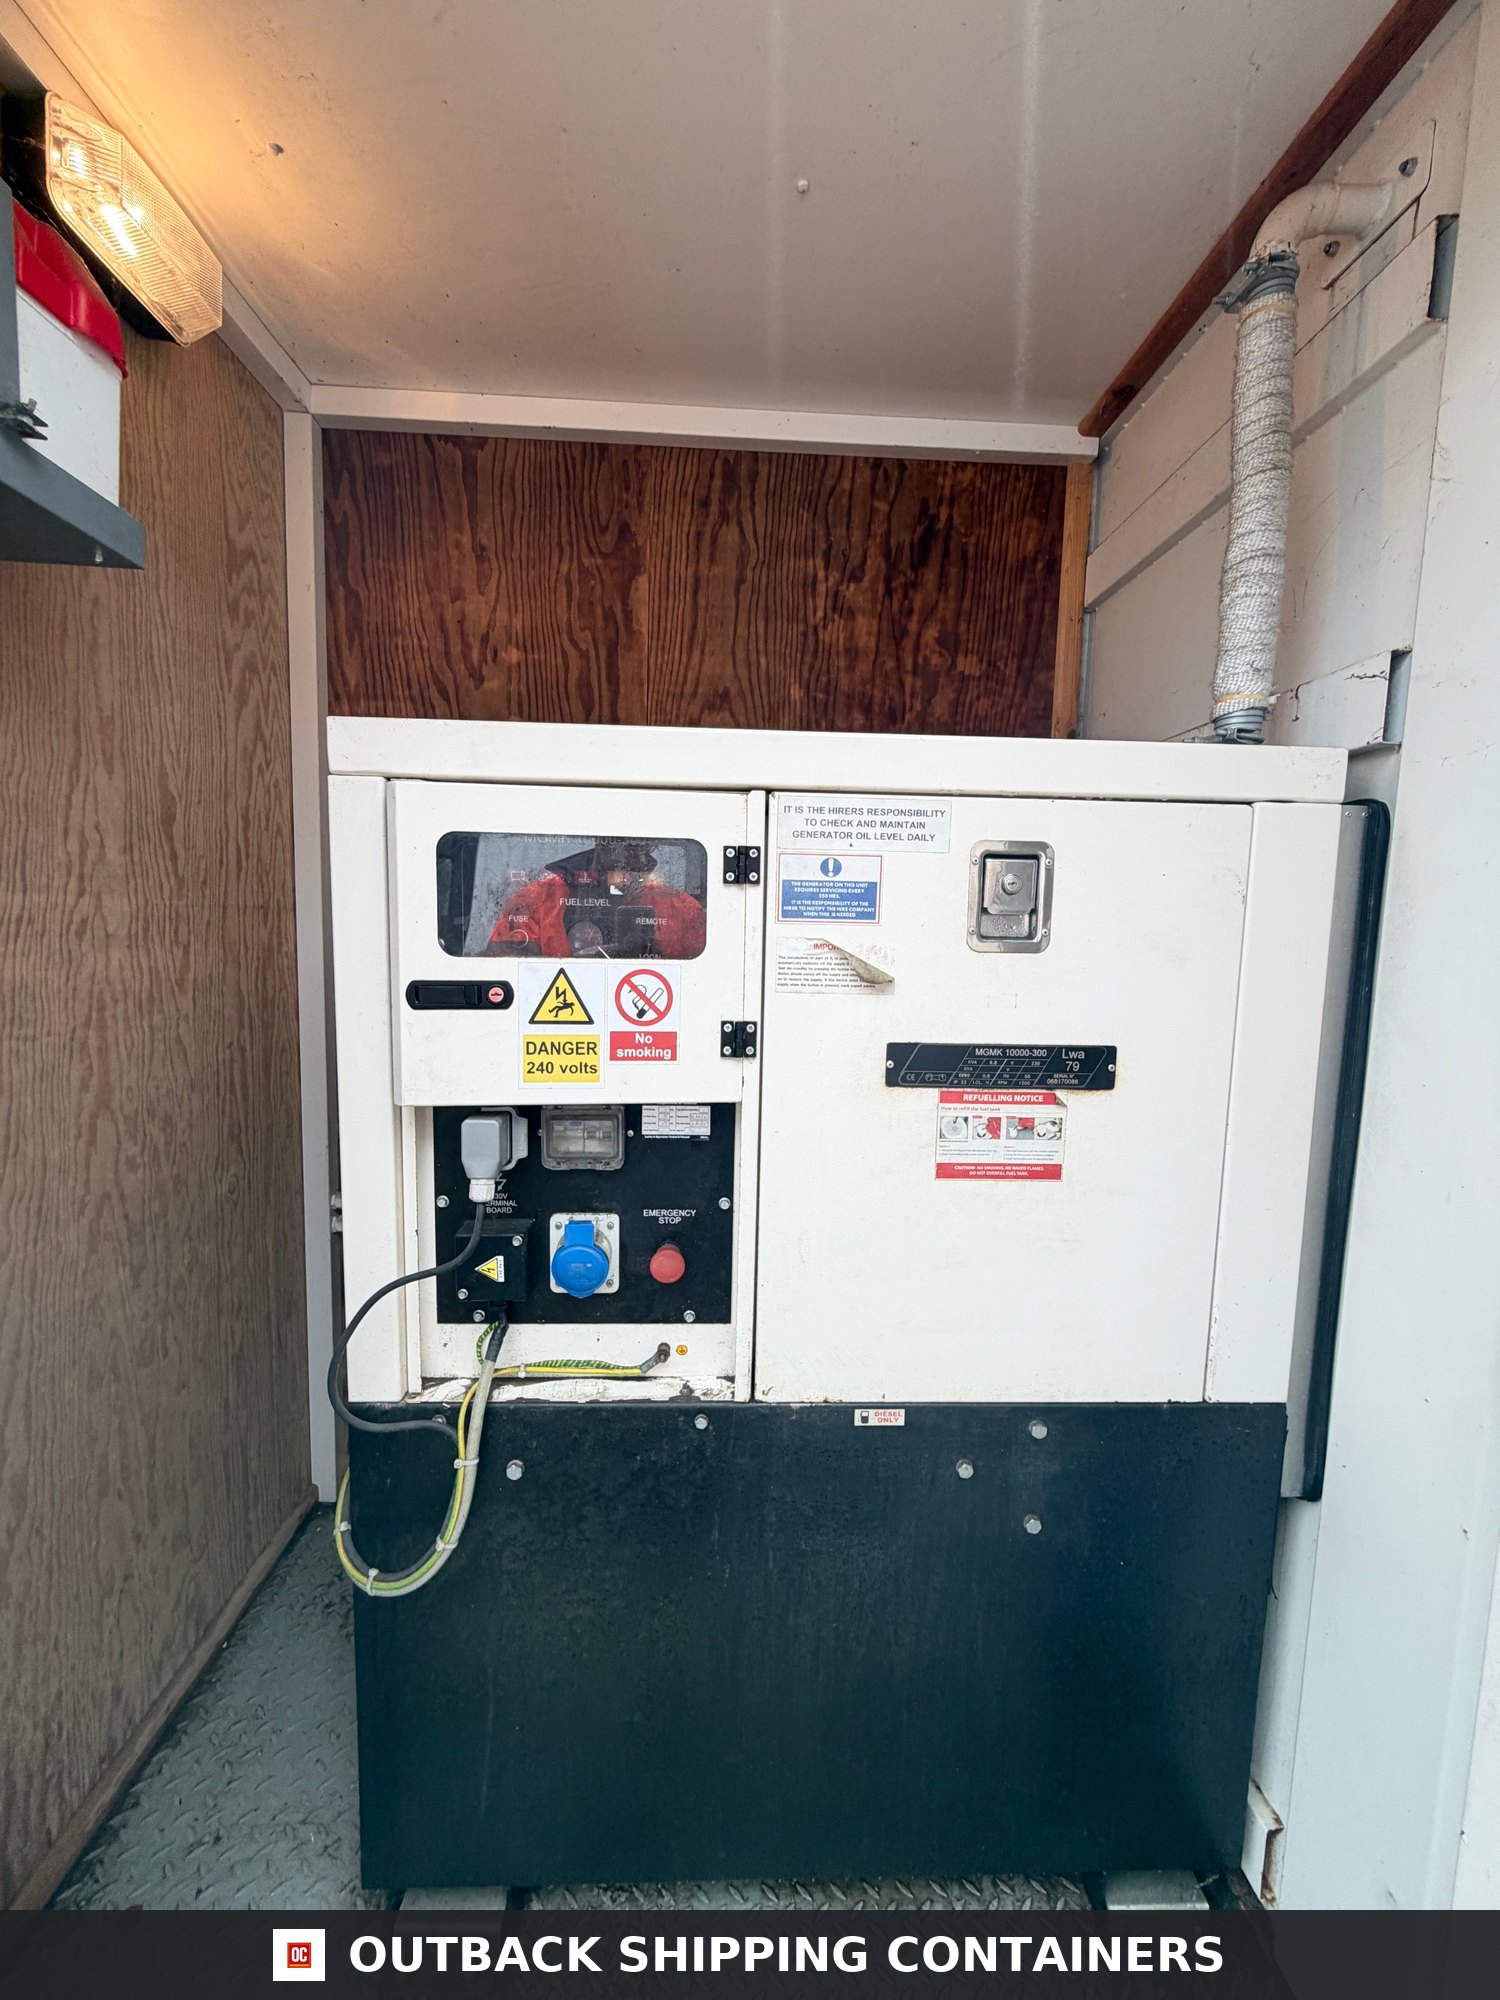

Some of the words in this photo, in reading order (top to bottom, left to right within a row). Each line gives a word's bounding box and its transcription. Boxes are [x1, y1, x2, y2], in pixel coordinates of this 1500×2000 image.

[795, 806, 804, 814] IS
[807, 806, 826, 814] THE
[828, 807, 864, 816] HIRERS
[867, 808, 946, 818] RESPONSIBILITY
[820, 819, 853, 828] CHECK
[856, 820, 877, 828] AND
[880, 821, 926, 829] MAINTAIN
[793, 831, 853, 840] GENERATOR
[856, 832, 871, 840] OIL
[874, 833, 904, 841] LEVEL
[907, 834, 935, 842] DAILY
[560, 898, 582, 907] FUEL
[584, 899, 611, 907] LEVEL
[508, 915, 529, 923] FUSE
[635, 1033, 653, 1044] No
[526, 1041, 598, 1056] DANGER
[616, 1047, 672, 1060] smoking
[975, 1048, 1003, 1056] MGMK
[1006, 1049, 1047, 1057] 10000-300
[1062, 1049, 1085, 1059] Lwa
[527, 1062, 554, 1074] 240
[560, 1062, 598, 1074] volts
[1065, 1061, 1080, 1072] 79
[963, 1094, 1013, 1102] REFUELLING
[643, 1209, 697, 1217] EMERGENCY
